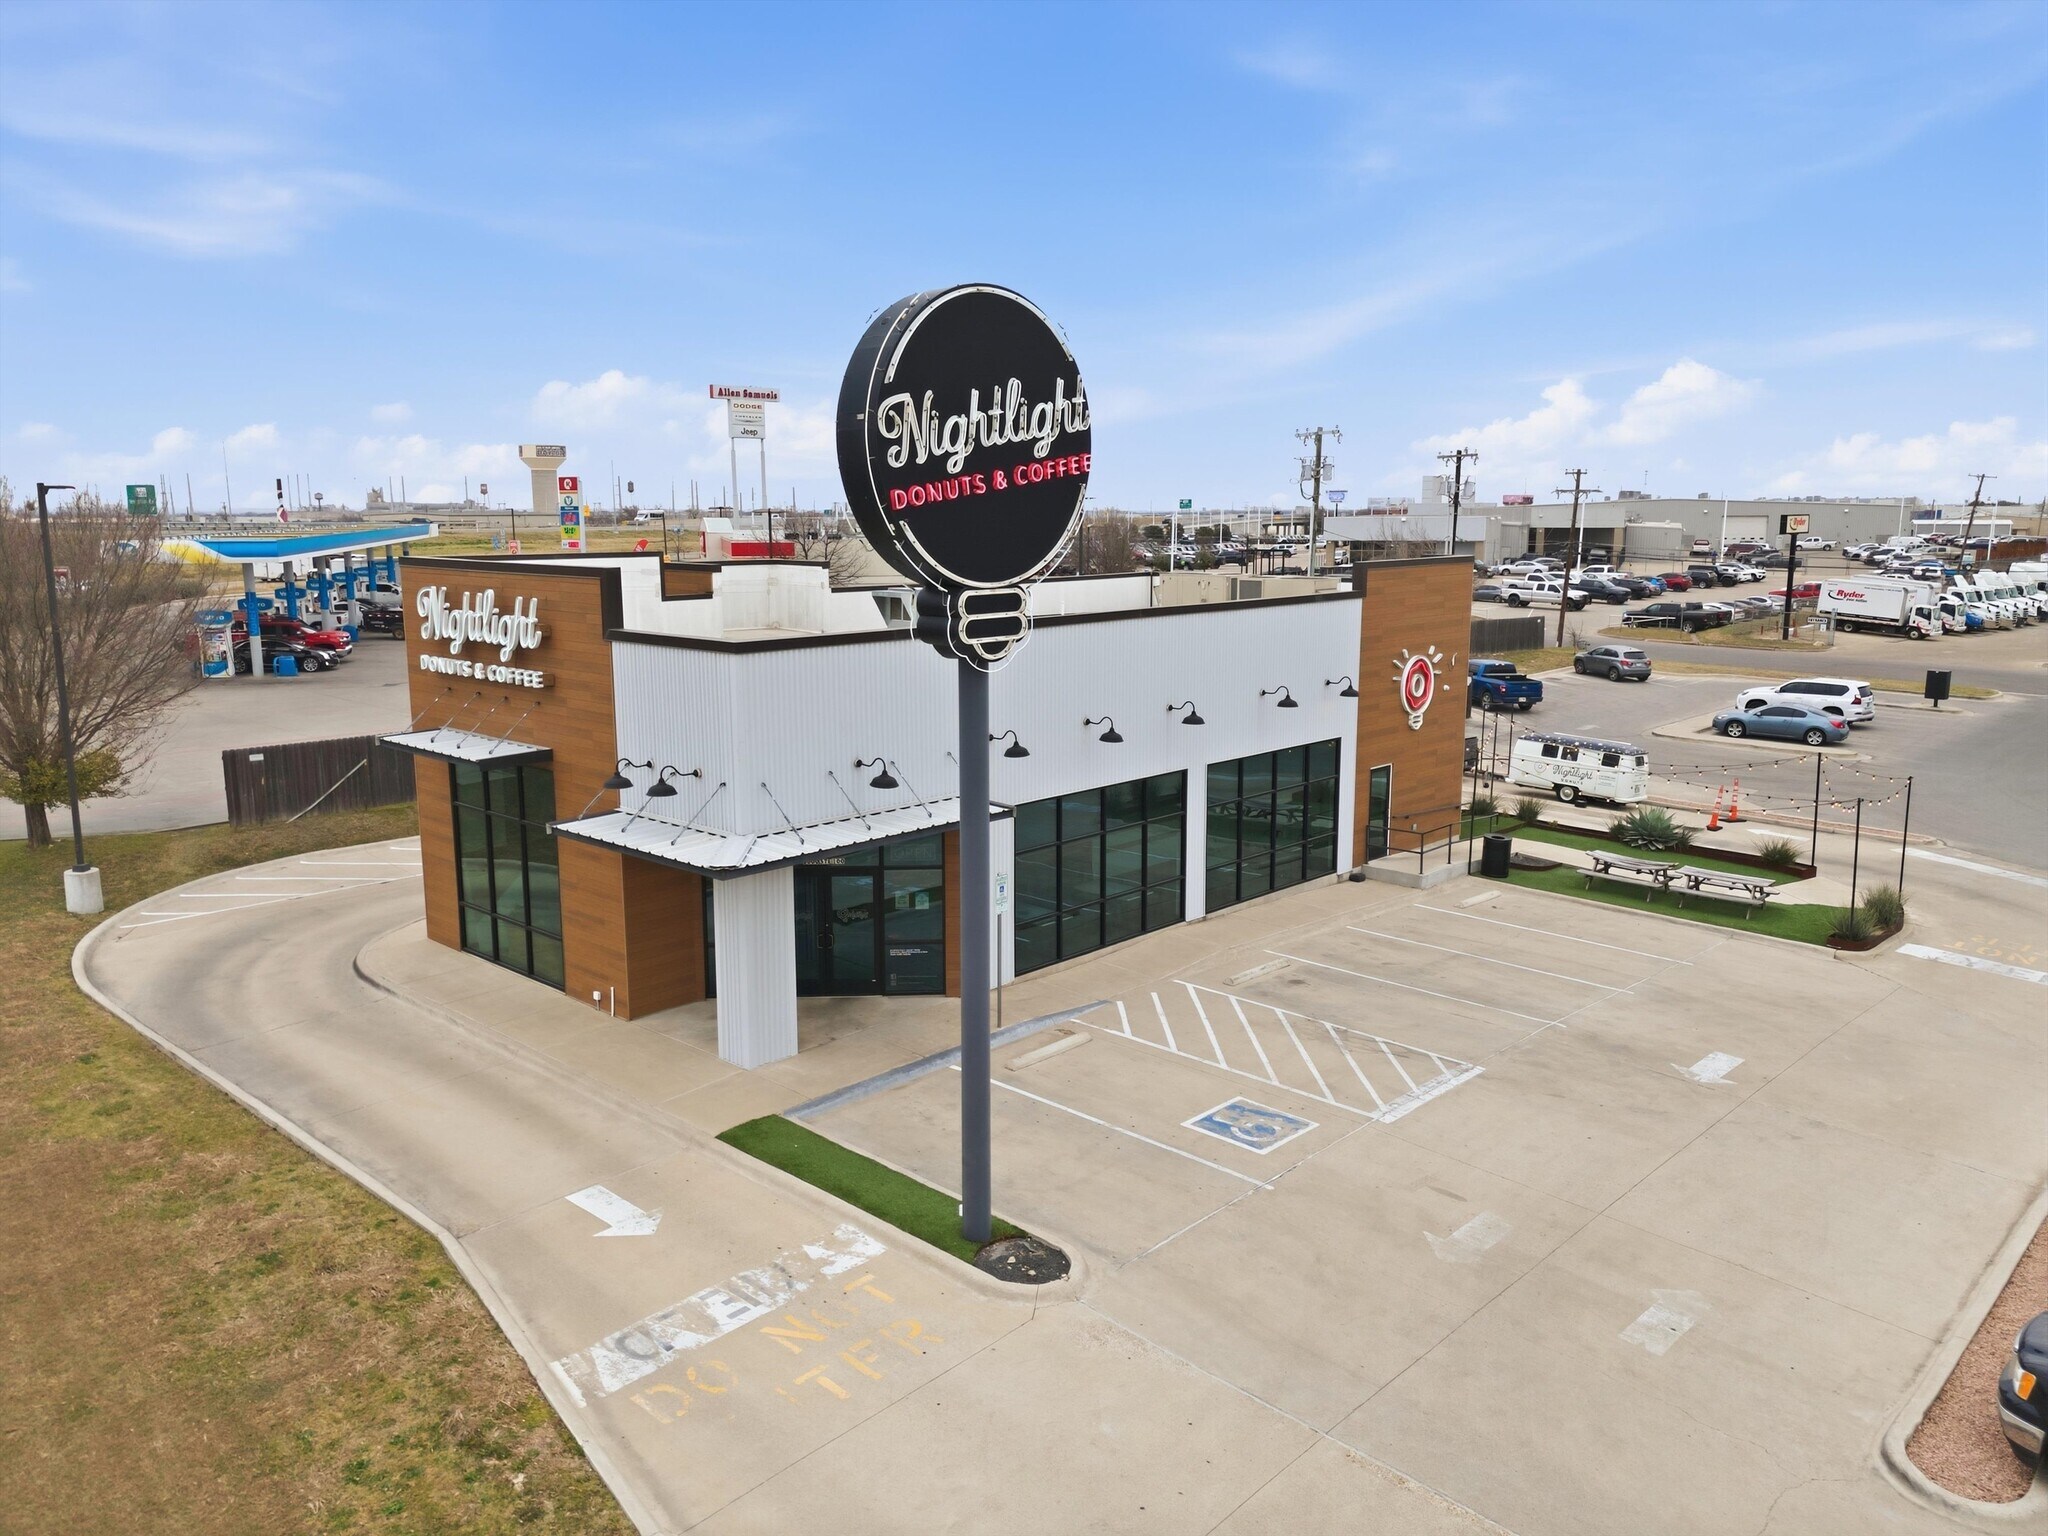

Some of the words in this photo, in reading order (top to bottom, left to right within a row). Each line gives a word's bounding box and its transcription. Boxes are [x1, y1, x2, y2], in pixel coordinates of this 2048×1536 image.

[717, 387, 741, 397] Allen
[743, 389, 778, 400] Samuels
[740, 427, 758, 436] Jeep
[878, 375, 1091, 474] Nightlight
[890, 474, 987, 511] DONUTS
[992, 469, 1008, 490] &
[1013, 452, 1092, 486] COFFEE
[1836, 589, 1866, 599] Ryder
[416, 585, 543, 663] Nightlight
[420, 654, 473, 678] DONUTS
[474, 662, 486, 680] &
[486, 664, 544, 689] COFFEE
[1552, 763, 1594, 781] Nightlight
[631, 1359, 739, 1425] DO
[759, 1273, 896, 1355] NOT
